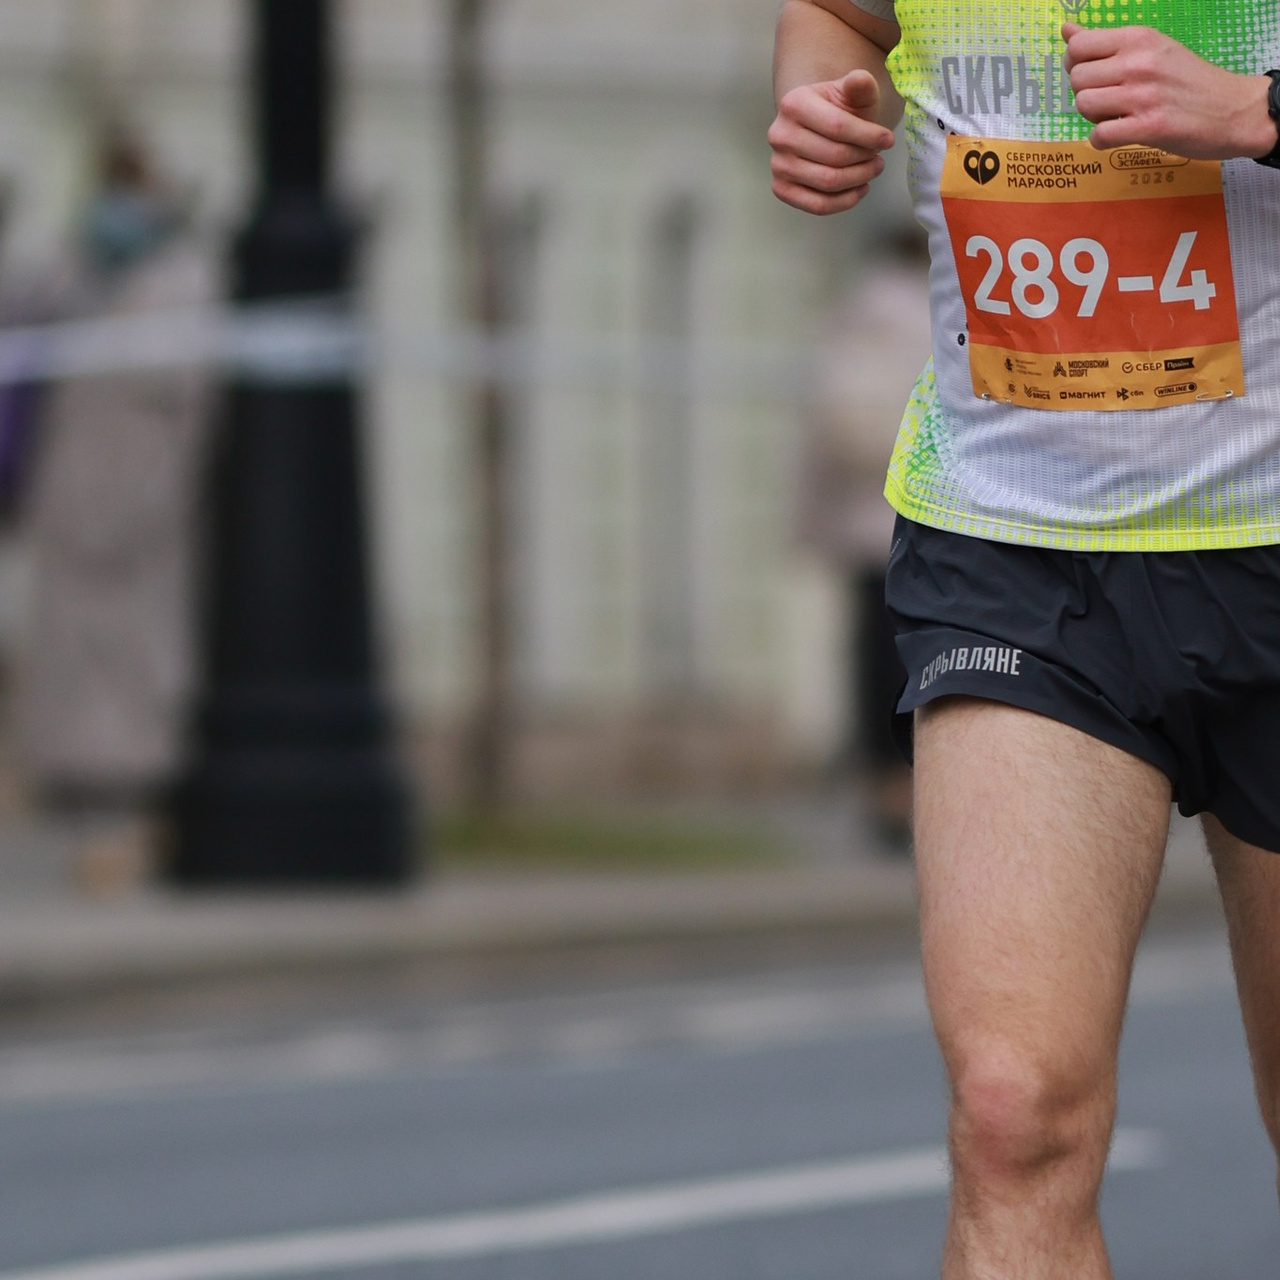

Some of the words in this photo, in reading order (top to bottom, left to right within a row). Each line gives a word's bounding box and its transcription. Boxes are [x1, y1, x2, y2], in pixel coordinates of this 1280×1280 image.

[1006, 152, 1074, 162] СБЕРПРАЙМ
[1118, 158, 1162, 167] ЭСТАФЕТА
[1006, 161, 1102, 175] МОСКОВСКИЙ
[1007, 177, 1077, 189] МАРАФОН
[1130, 171, 1175, 185] 2026
[965, 231, 1217, 319] 289-4
[1068, 358, 1109, 369] МОСКОВСКИЙ
[1136, 363, 1162, 371] СБЕР
[1069, 369, 1088, 377] СПОРТ
[1157, 385, 1188, 395] WINLINE
[919, 647, 1022, 690] СКРЫВЛЯНЕ
